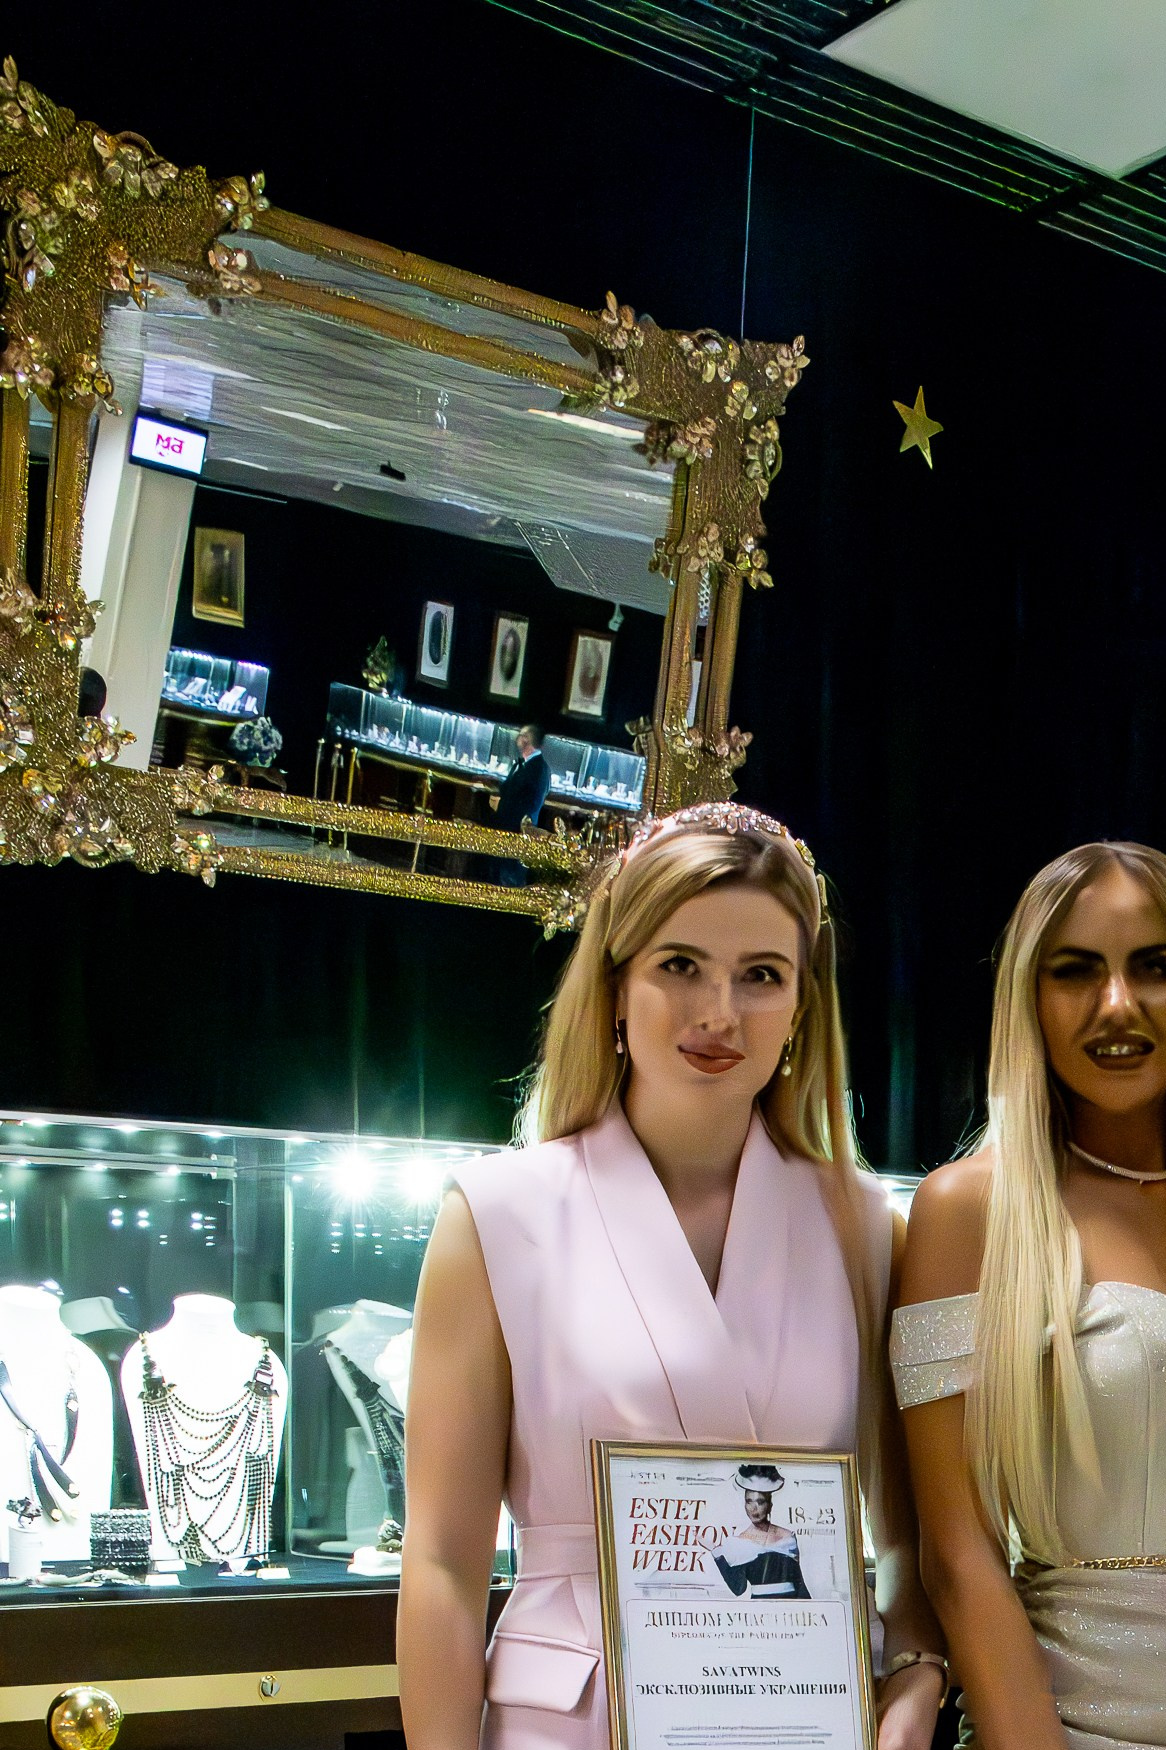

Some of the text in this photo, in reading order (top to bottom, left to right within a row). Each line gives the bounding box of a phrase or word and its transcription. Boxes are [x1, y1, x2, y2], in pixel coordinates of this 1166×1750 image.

[629, 1497, 706, 1520] ESTET
[632, 1549, 706, 1573] WEEK
[645, 1611, 721, 1628] ДИПЛОМ
[702, 1666, 782, 1677] SAVATWINS
[636, 1683, 847, 1696] ЭКСКЛЮЗИВНЫЕ УКРАШЕНИЯ
